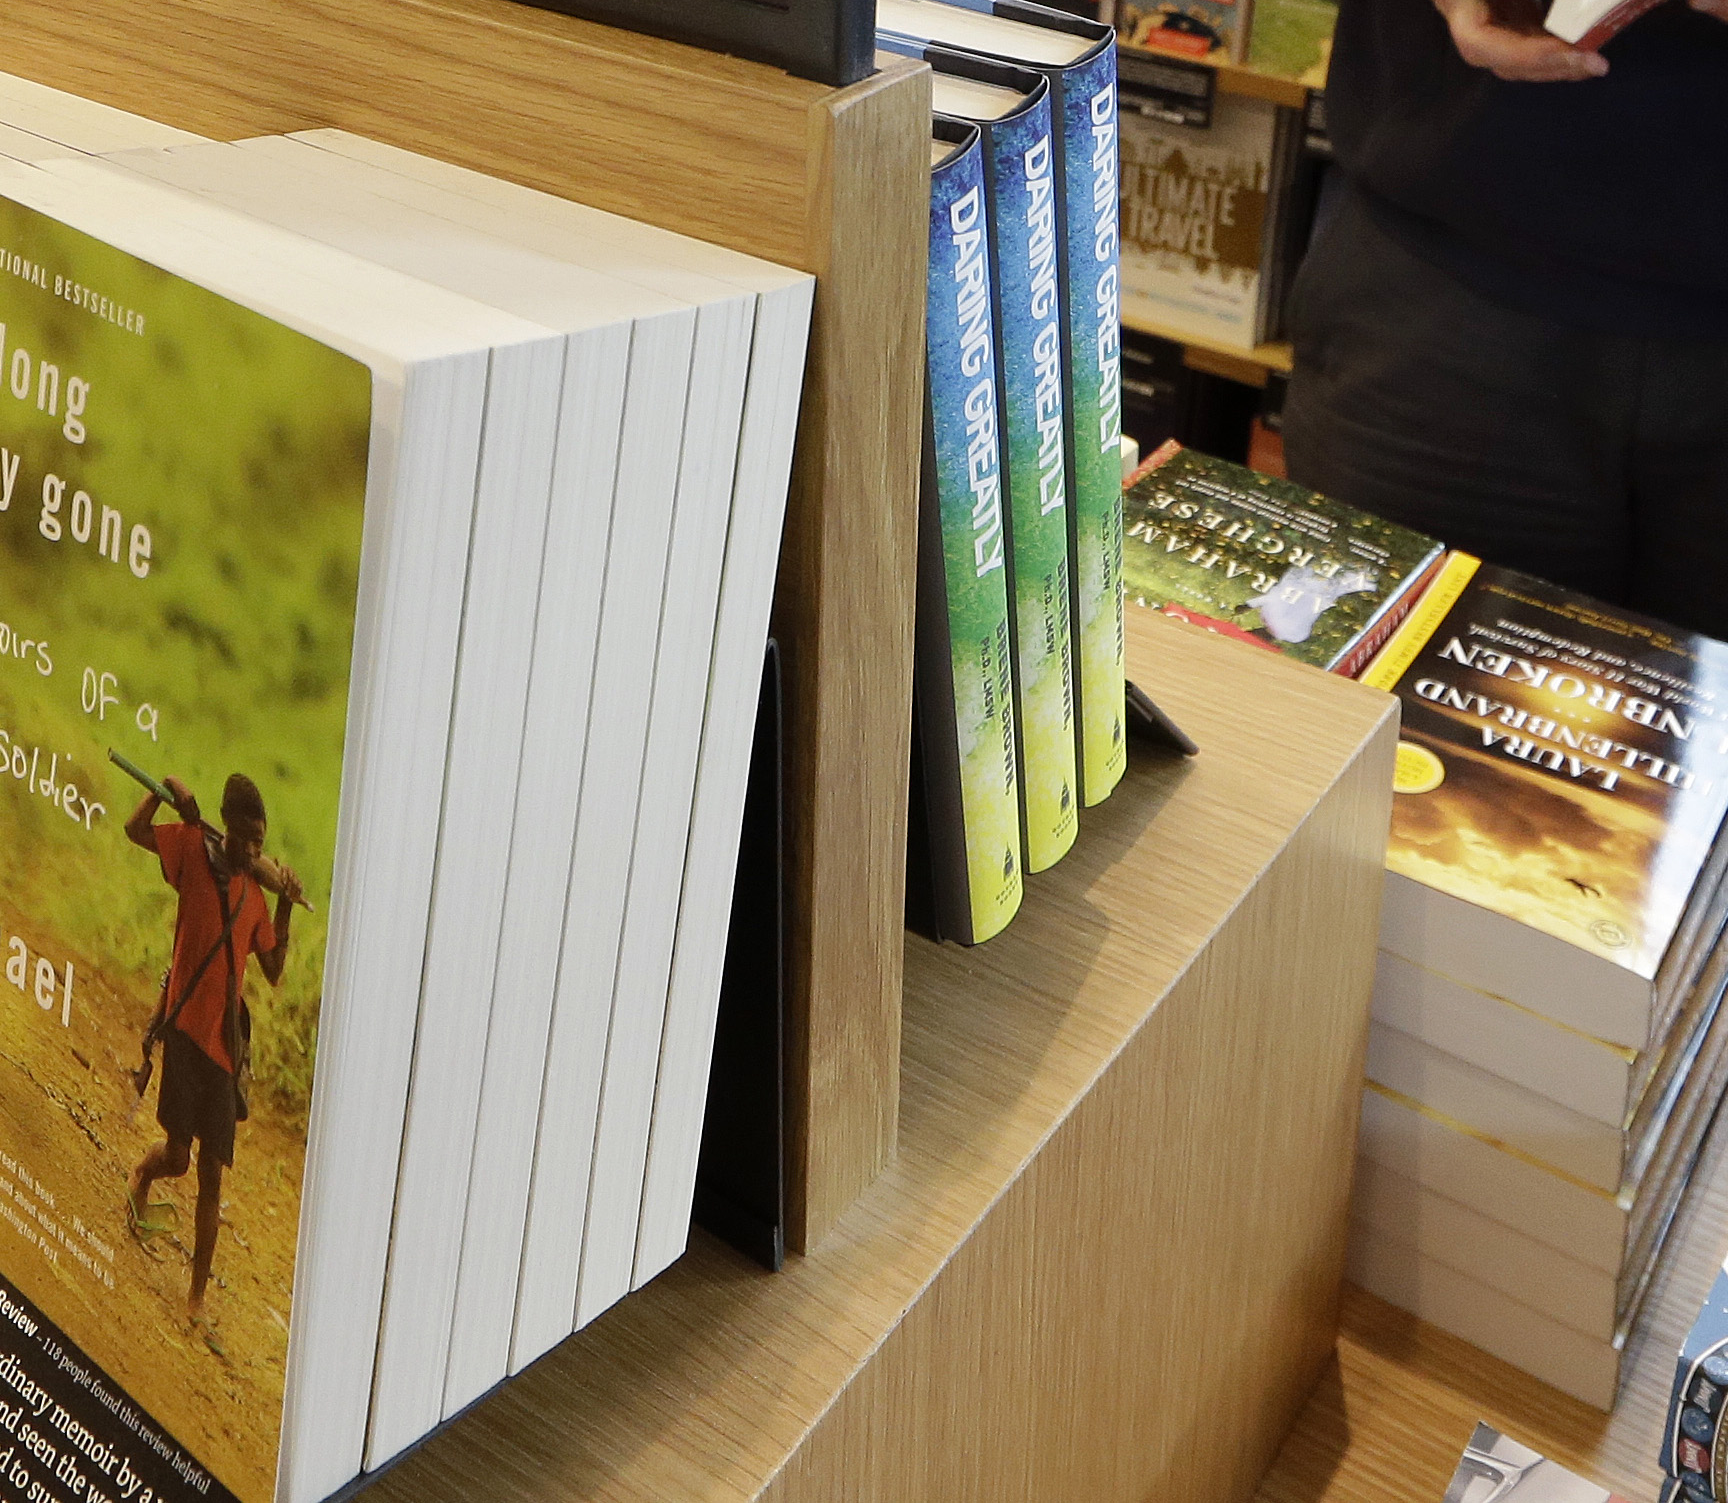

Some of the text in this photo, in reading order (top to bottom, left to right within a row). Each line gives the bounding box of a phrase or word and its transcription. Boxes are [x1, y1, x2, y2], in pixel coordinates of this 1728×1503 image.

[1089, 80, 1123, 455] DARING GREATLY
[1128, 204, 1218, 258] TRAVEL
[53, 274, 145, 336] BESTSELLER
[948, 185, 986, 380] DARING
[1024, 133, 1068, 517] DARING GREATLY
[966, 376, 1006, 579] GREATLY
[37, 472, 152, 579] gone
[1147, 489, 1370, 591] VERGHESE
[1044, 615, 1056, 657] LMSW
[135, 702, 158, 742] a
[983, 678, 995, 720] LMSW
[1480, 725, 1622, 793] LAURA
[7, 1458, 29, 1489] to
[16, 1422, 56, 1469] seen
[54, 1453, 86, 1495] the
[48, 1403, 119, 1476] memoir
[114, 1456, 142, 1498] by
[138, 1486, 153, 1503] a
